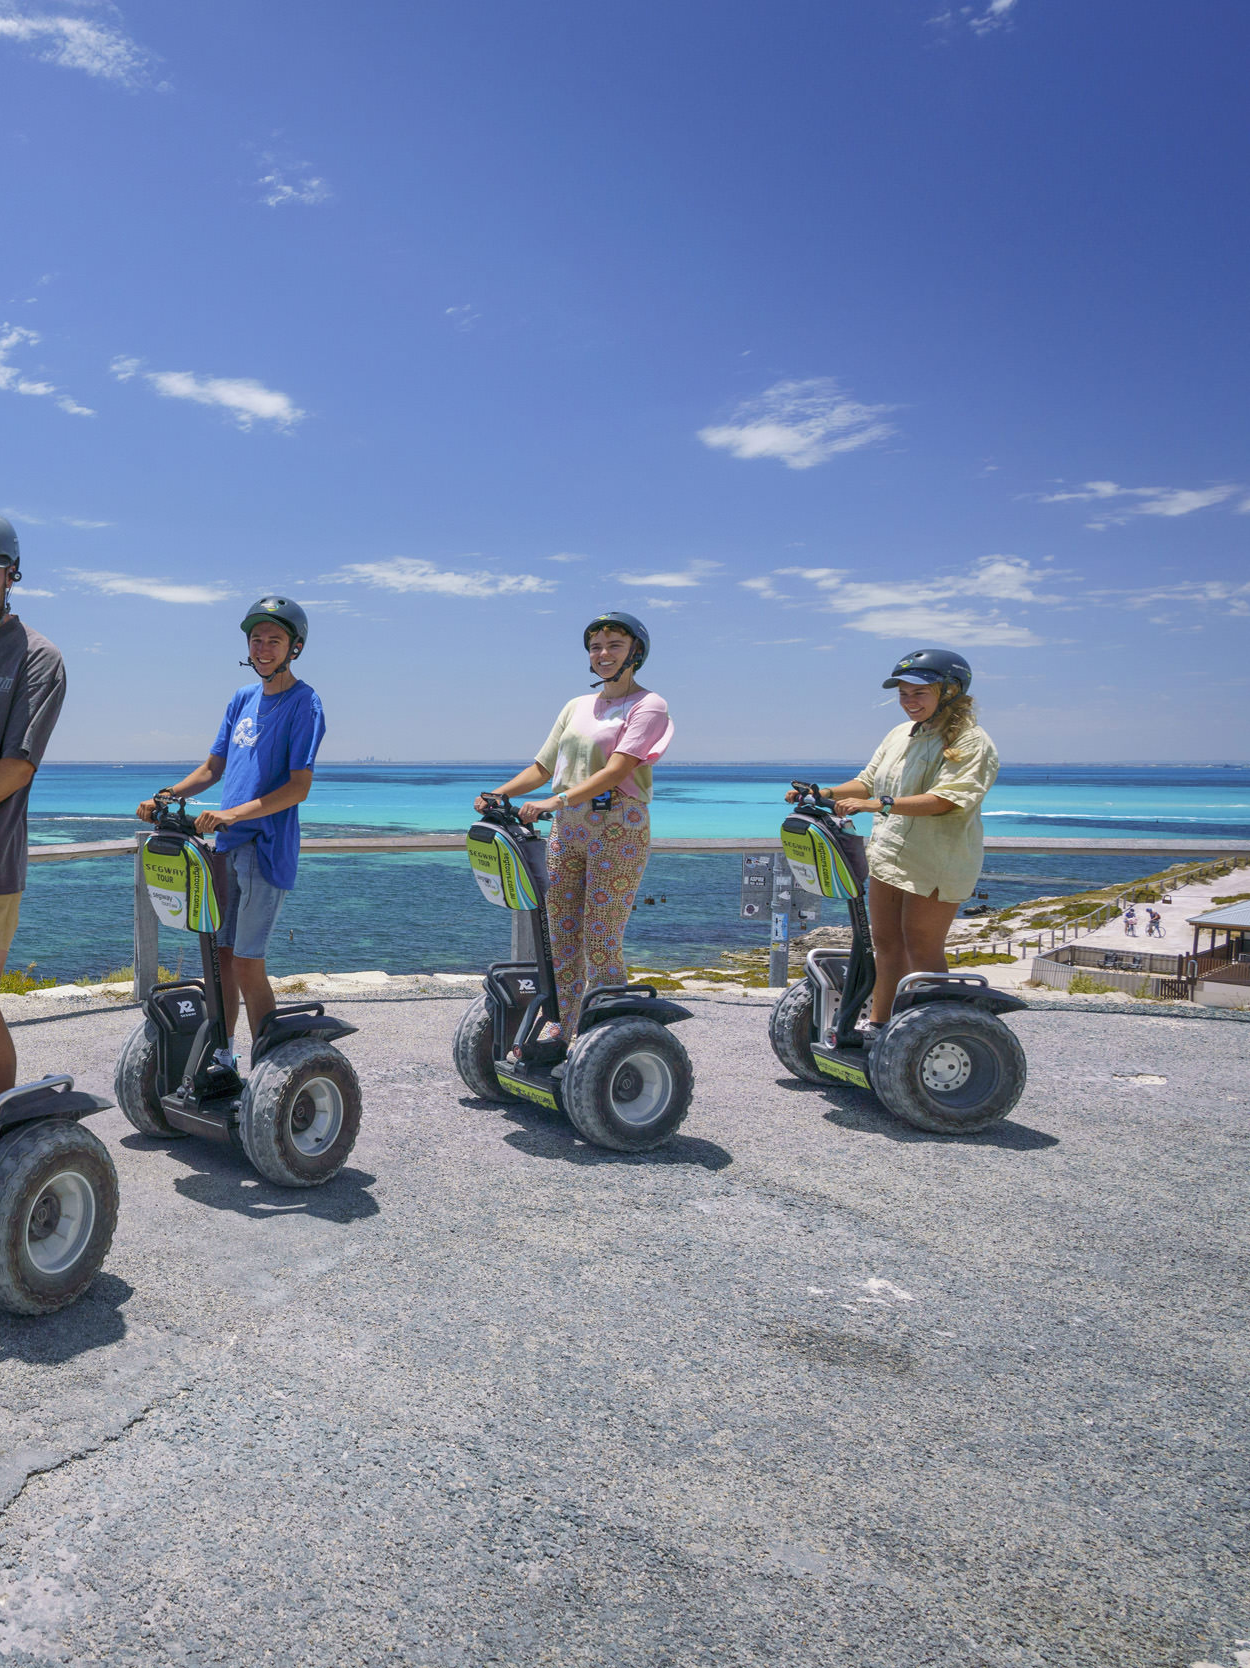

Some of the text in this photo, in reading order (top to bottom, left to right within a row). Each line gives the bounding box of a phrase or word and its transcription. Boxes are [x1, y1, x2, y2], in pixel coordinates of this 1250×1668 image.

[469, 849, 497, 862] SEGWAY
[145, 863, 185, 877] SEGWAY
[157, 873, 174, 884] TOUR
